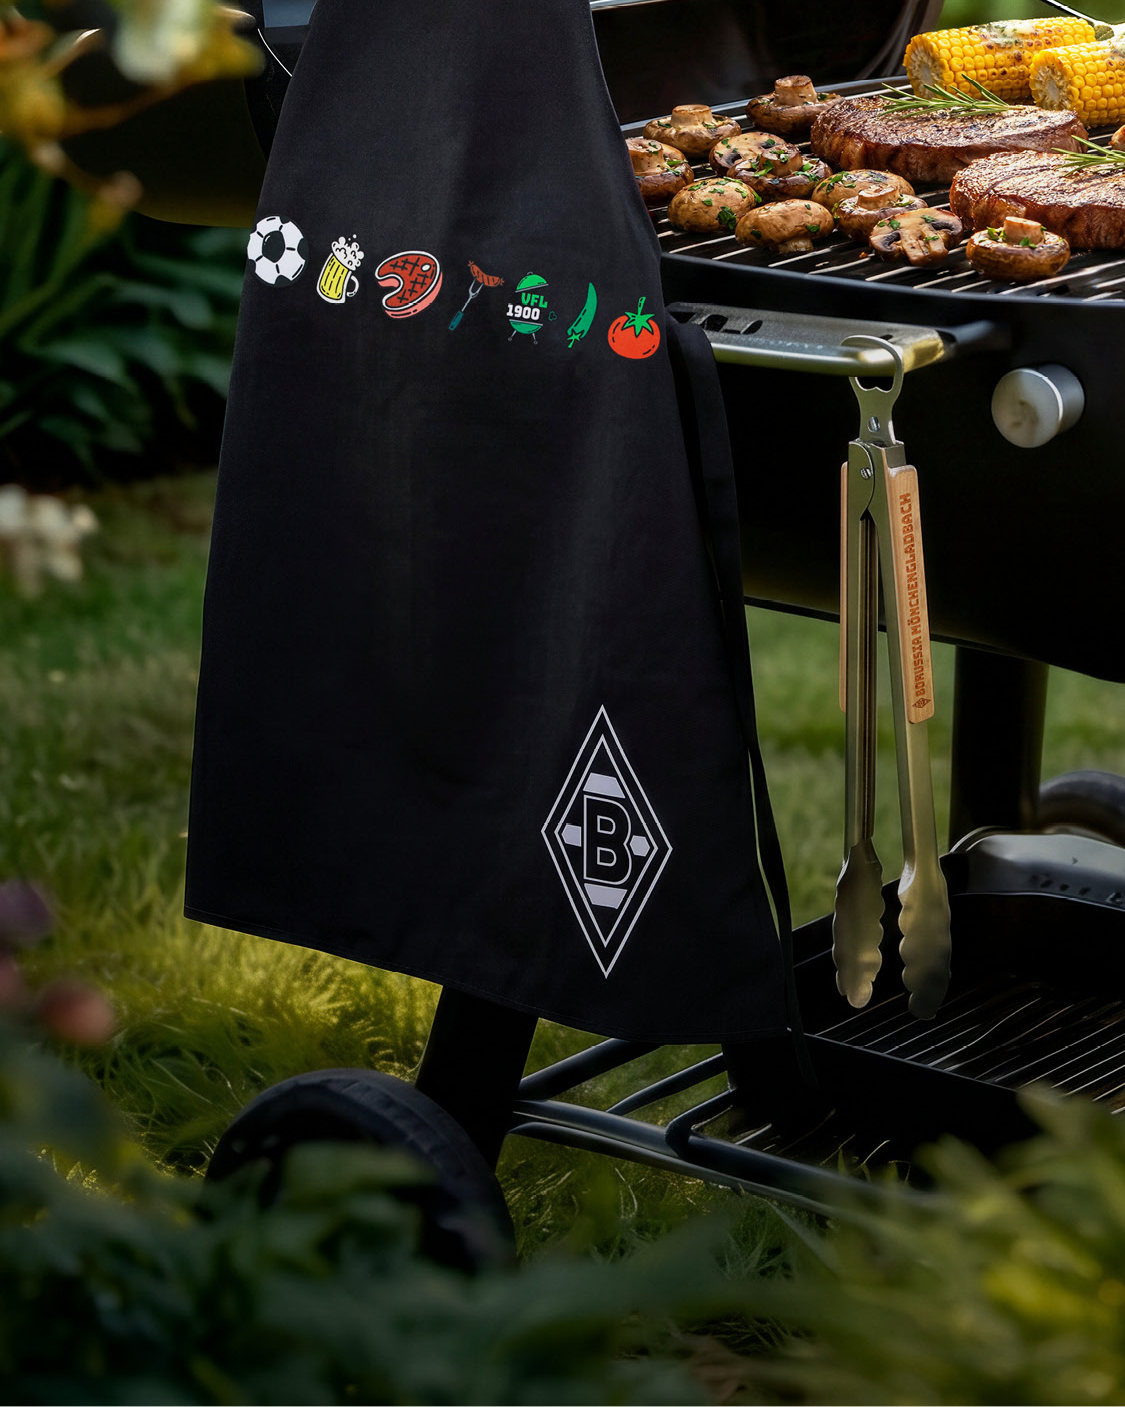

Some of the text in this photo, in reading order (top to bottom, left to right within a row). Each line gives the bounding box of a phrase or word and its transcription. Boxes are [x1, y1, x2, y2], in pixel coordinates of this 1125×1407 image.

[506, 303, 541, 321] 1900
[521, 292, 548, 308] VFL
[899, 492, 922, 634] MÖNCHENGLADBACH
[908, 636, 926, 697] BORUSSIA
[583, 794, 632, 885] B
